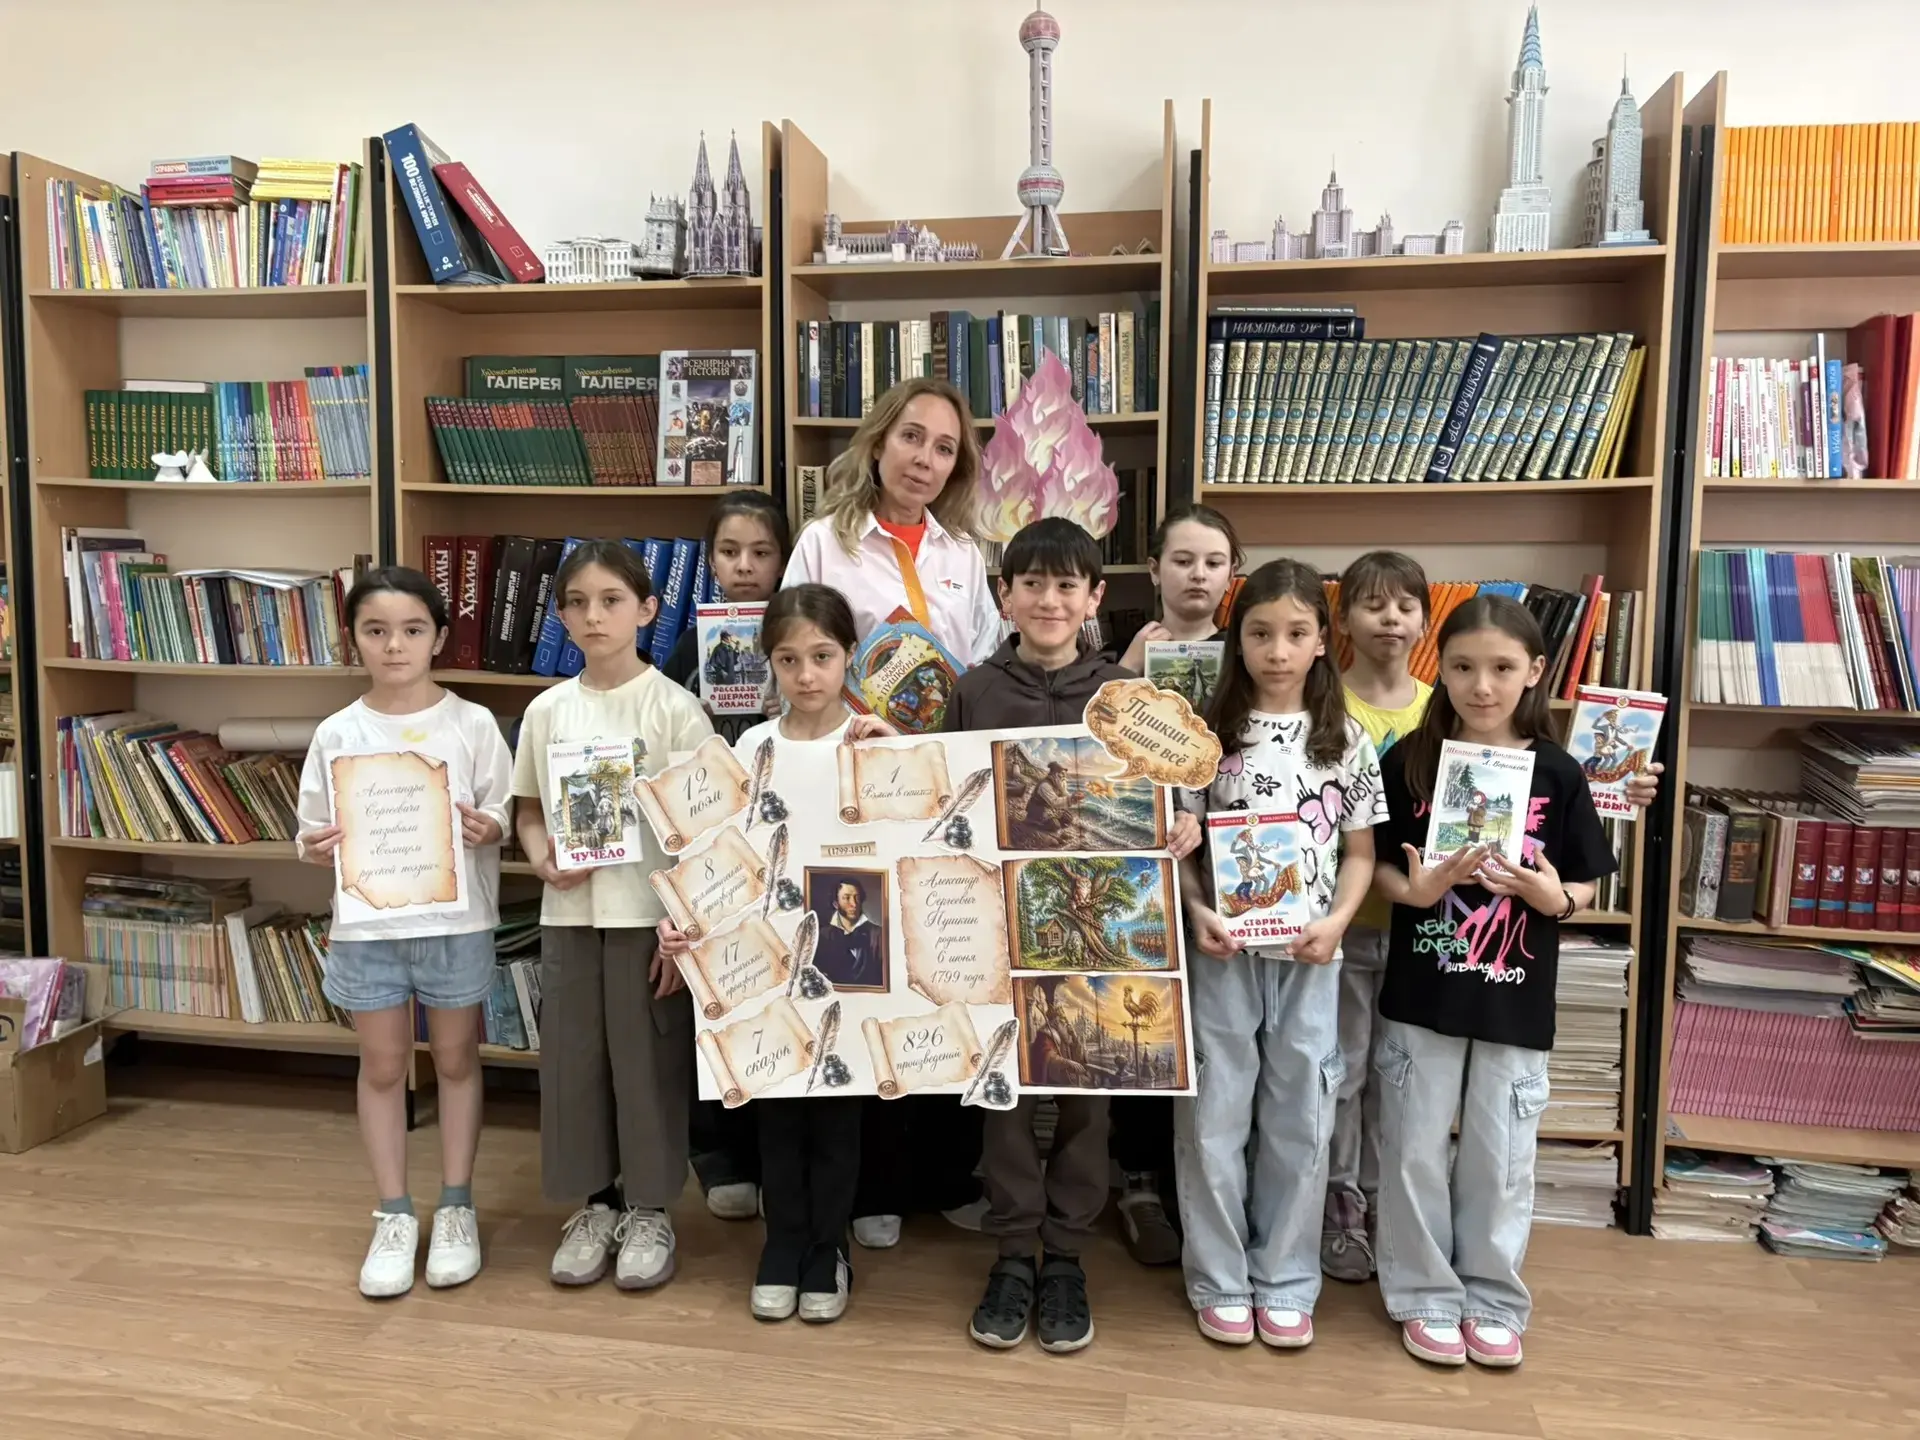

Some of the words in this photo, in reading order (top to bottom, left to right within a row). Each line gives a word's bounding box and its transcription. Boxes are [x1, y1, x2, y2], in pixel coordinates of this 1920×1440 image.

[401, 152, 420, 178] 100
[683, 358, 736, 369] ВСЕМИРНАЯ
[688, 366, 731, 376] ИСТОРИЯ
[486, 376, 562, 391] ГАЛЕРЕЯ
[580, 376, 658, 390] ГАЛЕРЕЯ
[1455, 354, 1488, 418] ПУШКИН
[1440, 453, 1447, 465] 2
[459, 549, 478, 620] Храмы
[663, 556, 678, 606] ДРЕВО
[670, 544, 688, 610] ПОЗНАНИЯ
[880, 657, 920, 698] ПУШКИНА
[881, 660, 904, 682] СКАЗКИ
[713, 684, 758, 693] РАССКАЗЫ
[718, 693, 762, 701] ШЕРЛОКЕ
[717, 700, 756, 708] ХОЛМСЕ
[1120, 696, 1190, 746] Пушкин
[1118, 725, 1161, 752] наше
[1160, 748, 1190, 768] всё
[890, 764, 902, 784] 1
[356, 782, 426, 798] Александра
[683, 767, 710, 801] 12
[689, 789, 723, 818] поэм
[1592, 792, 1619, 801] АРИК
[364, 800, 420, 820] Сергеевича
[1594, 800, 1632, 812] АБЫЧ
[370, 822, 418, 840] называли
[570, 848, 626, 862] ЧУЧЕЛО
[827, 845, 872, 856] (1799-1837)
[1427, 851, 1450, 861] ДЕВО
[357, 864, 396, 884] русской
[704, 857, 714, 881] 8
[919, 871, 980, 890] Александр
[926, 890, 976, 911] Сергеевич
[924, 910, 978, 932] Пушкин
[1243, 918, 1285, 926] СТАРИК
[1416, 919, 1458, 935] NEKO
[1228, 926, 1302, 938] ХОТТАБЫЧ
[935, 934, 972, 950] родился
[1413, 937, 1470, 954] LOVERS
[721, 940, 740, 966] 17
[937, 949, 946, 964] 6
[948, 954, 976, 963] июня
[930, 970, 960, 984] 1799
[1484, 967, 1526, 984] MOOD
[752, 1028, 764, 1055] 7
[902, 1025, 945, 1053] 826
[745, 1042, 792, 1078] сказок
[896, 1048, 961, 1076] произведений
